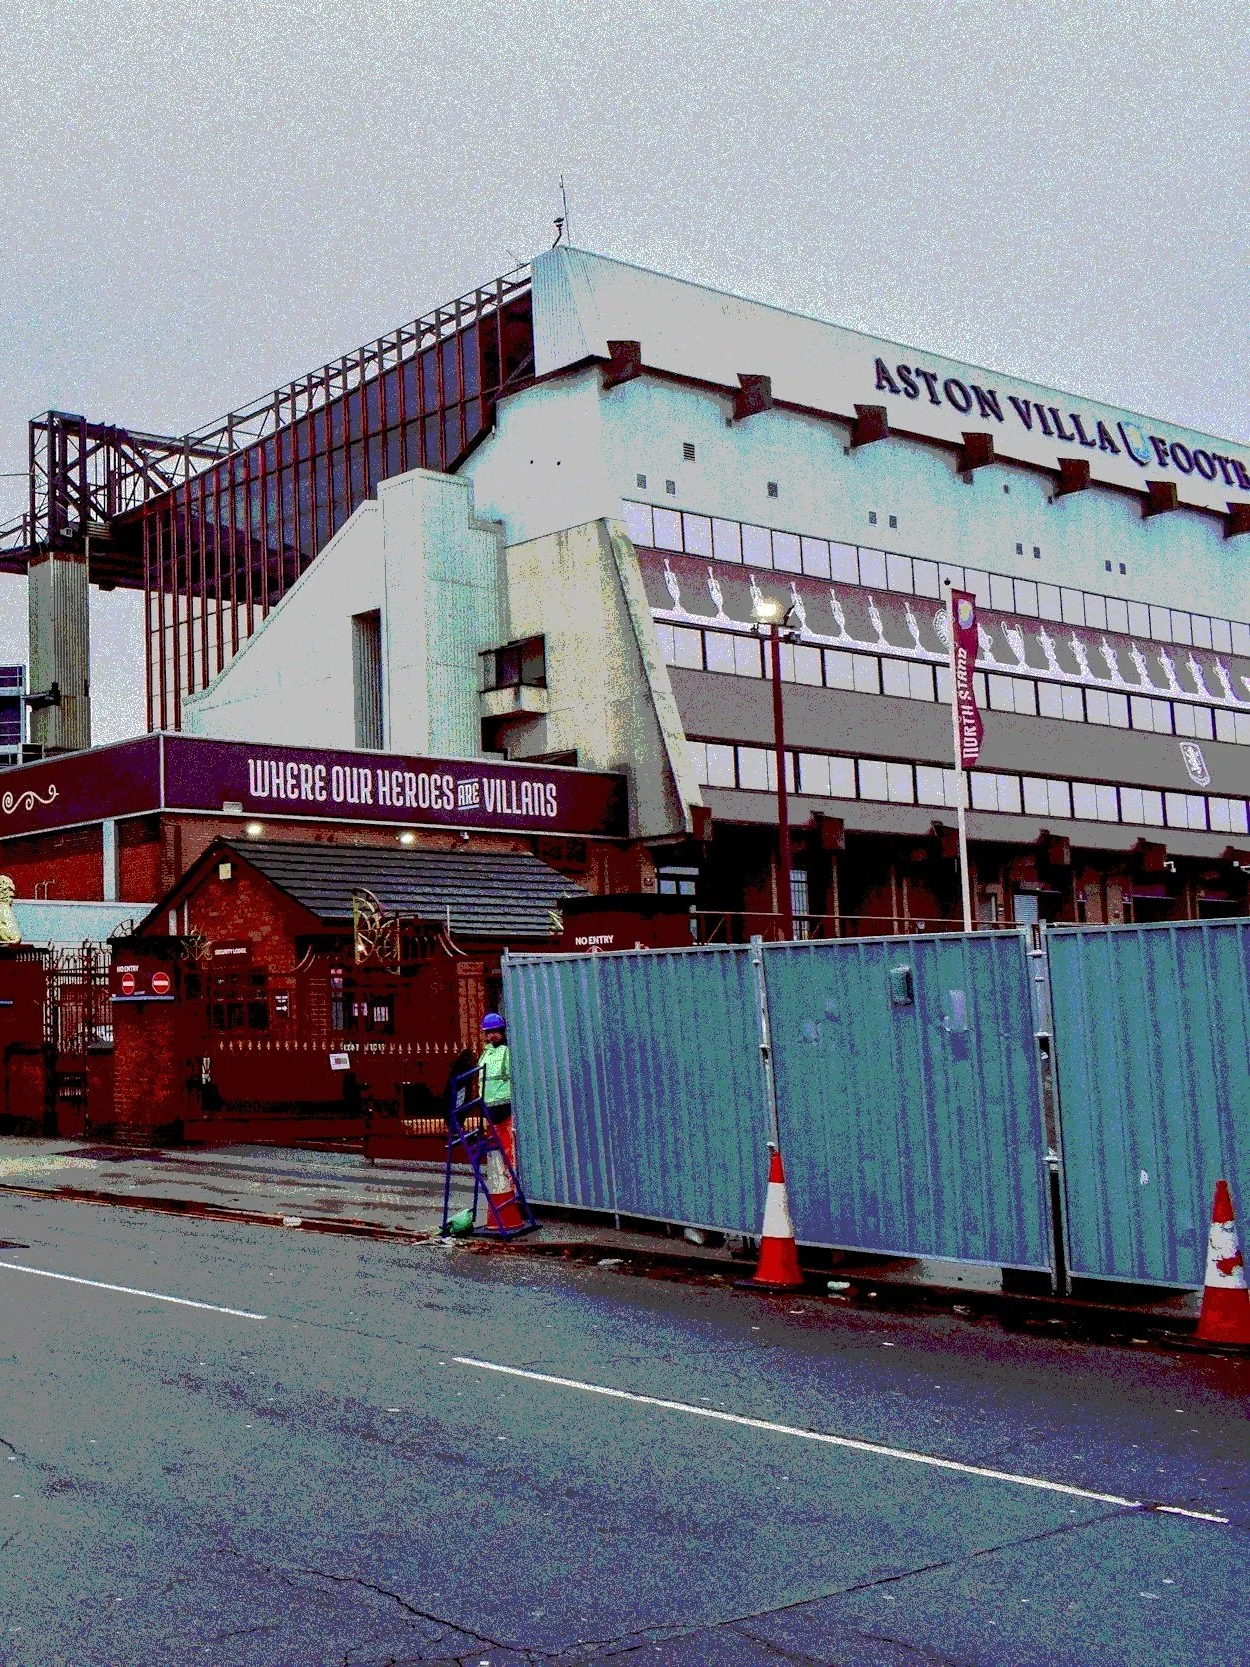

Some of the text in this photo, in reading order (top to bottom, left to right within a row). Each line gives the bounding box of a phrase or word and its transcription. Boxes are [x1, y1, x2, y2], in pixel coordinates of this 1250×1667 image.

[874, 357, 1004, 422] ASTON
[1008, 395, 1121, 455] VILLA
[957, 647, 979, 759] NORTH STAND
[248, 758, 558, 818] WHERE OUR HEROES ARE VILLANS
[232, 947, 247, 955] LODGE
[575, 935, 614, 946] NO ENTRY
[116, 964, 139, 973] NO ENTRY
